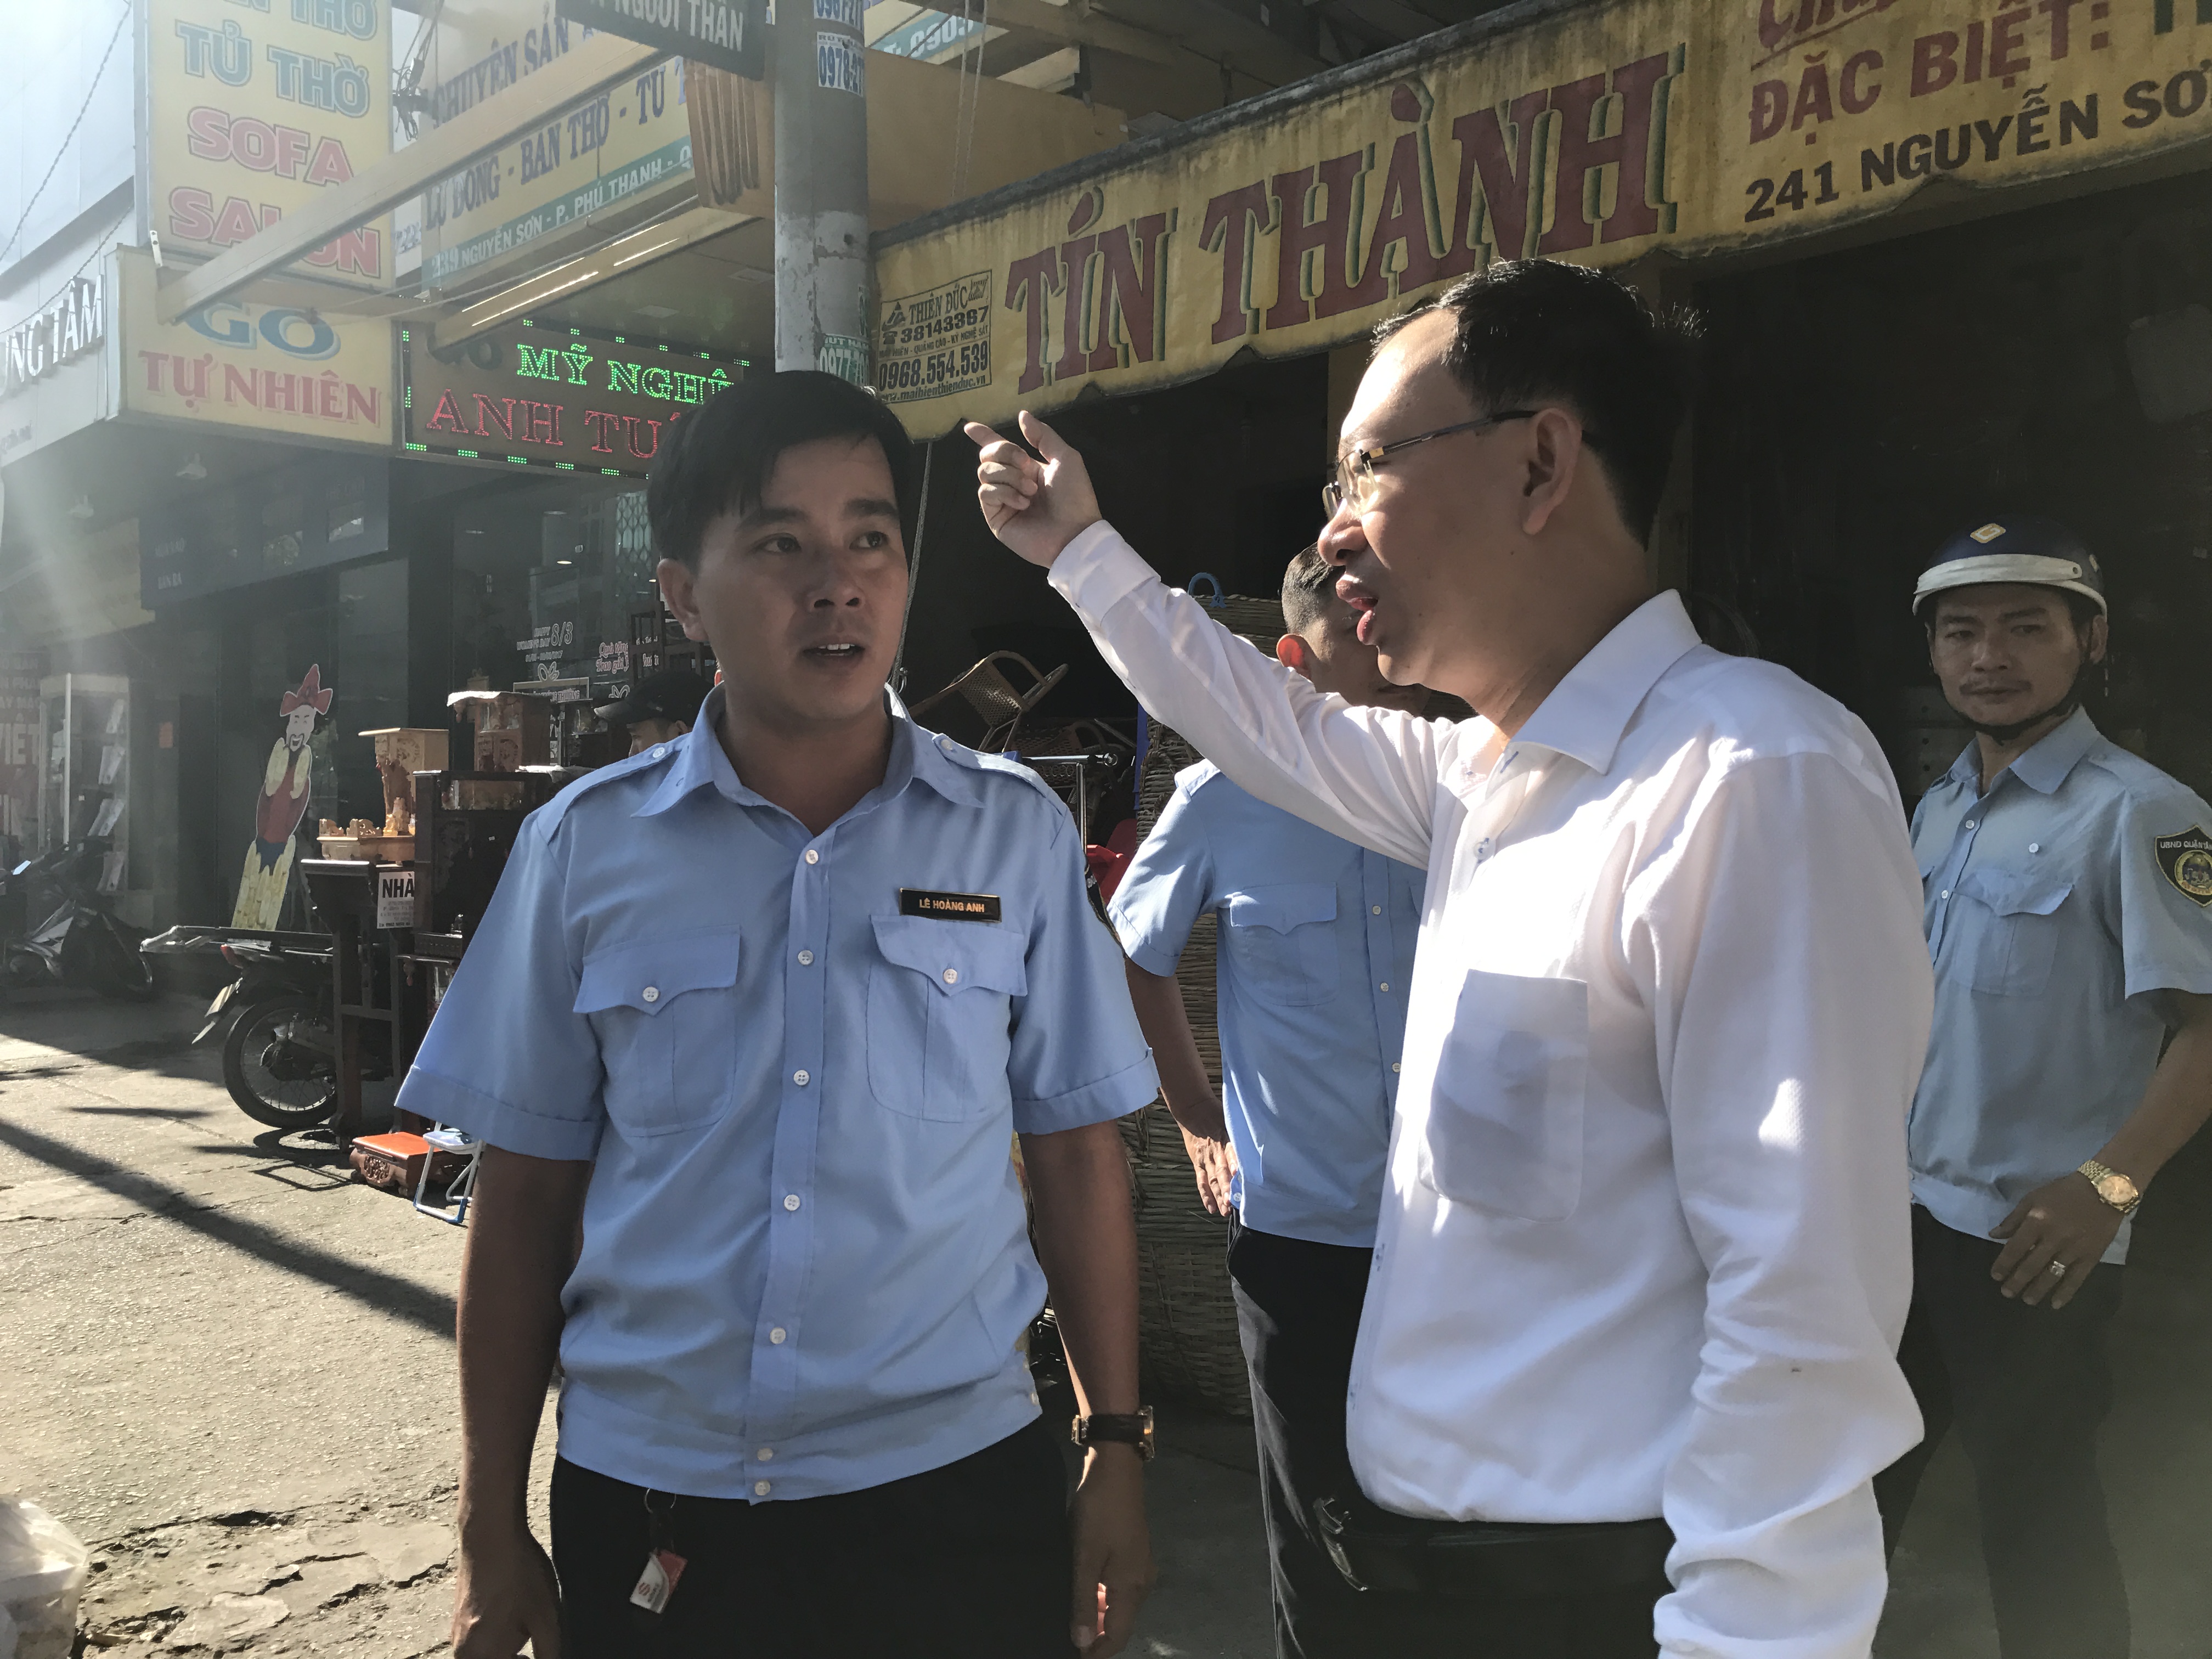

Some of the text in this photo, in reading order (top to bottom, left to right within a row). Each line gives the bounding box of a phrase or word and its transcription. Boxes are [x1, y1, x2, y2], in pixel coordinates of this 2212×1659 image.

[176, 20, 370, 117] TỦ THỜ
[1749, 49, 1884, 146] ĐẶC
[188, 107, 354, 187] SOFA
[1745, 59, 2212, 222] 241 NGUYỄN SƠ
[516, 214, 542, 245] SƠN
[574, 180, 603, 217] PHÚ
[1005, 45, 1681, 394] TÍN THÀNH
[50, 274, 103, 364] TÂM
[138, 351, 381, 428] TỰ NHIÊN
[517, 343, 593, 386] MỸ
[879, 341, 988, 392] 0968.554.539
[426, 388, 681, 459] ANH TU
[551, 621, 573, 646] 8/3
[2160, 840, 2182, 849] UBND
[382, 873, 414, 898] NHÀ
[919, 898, 985, 912] LÊ HOÀNG ANH
